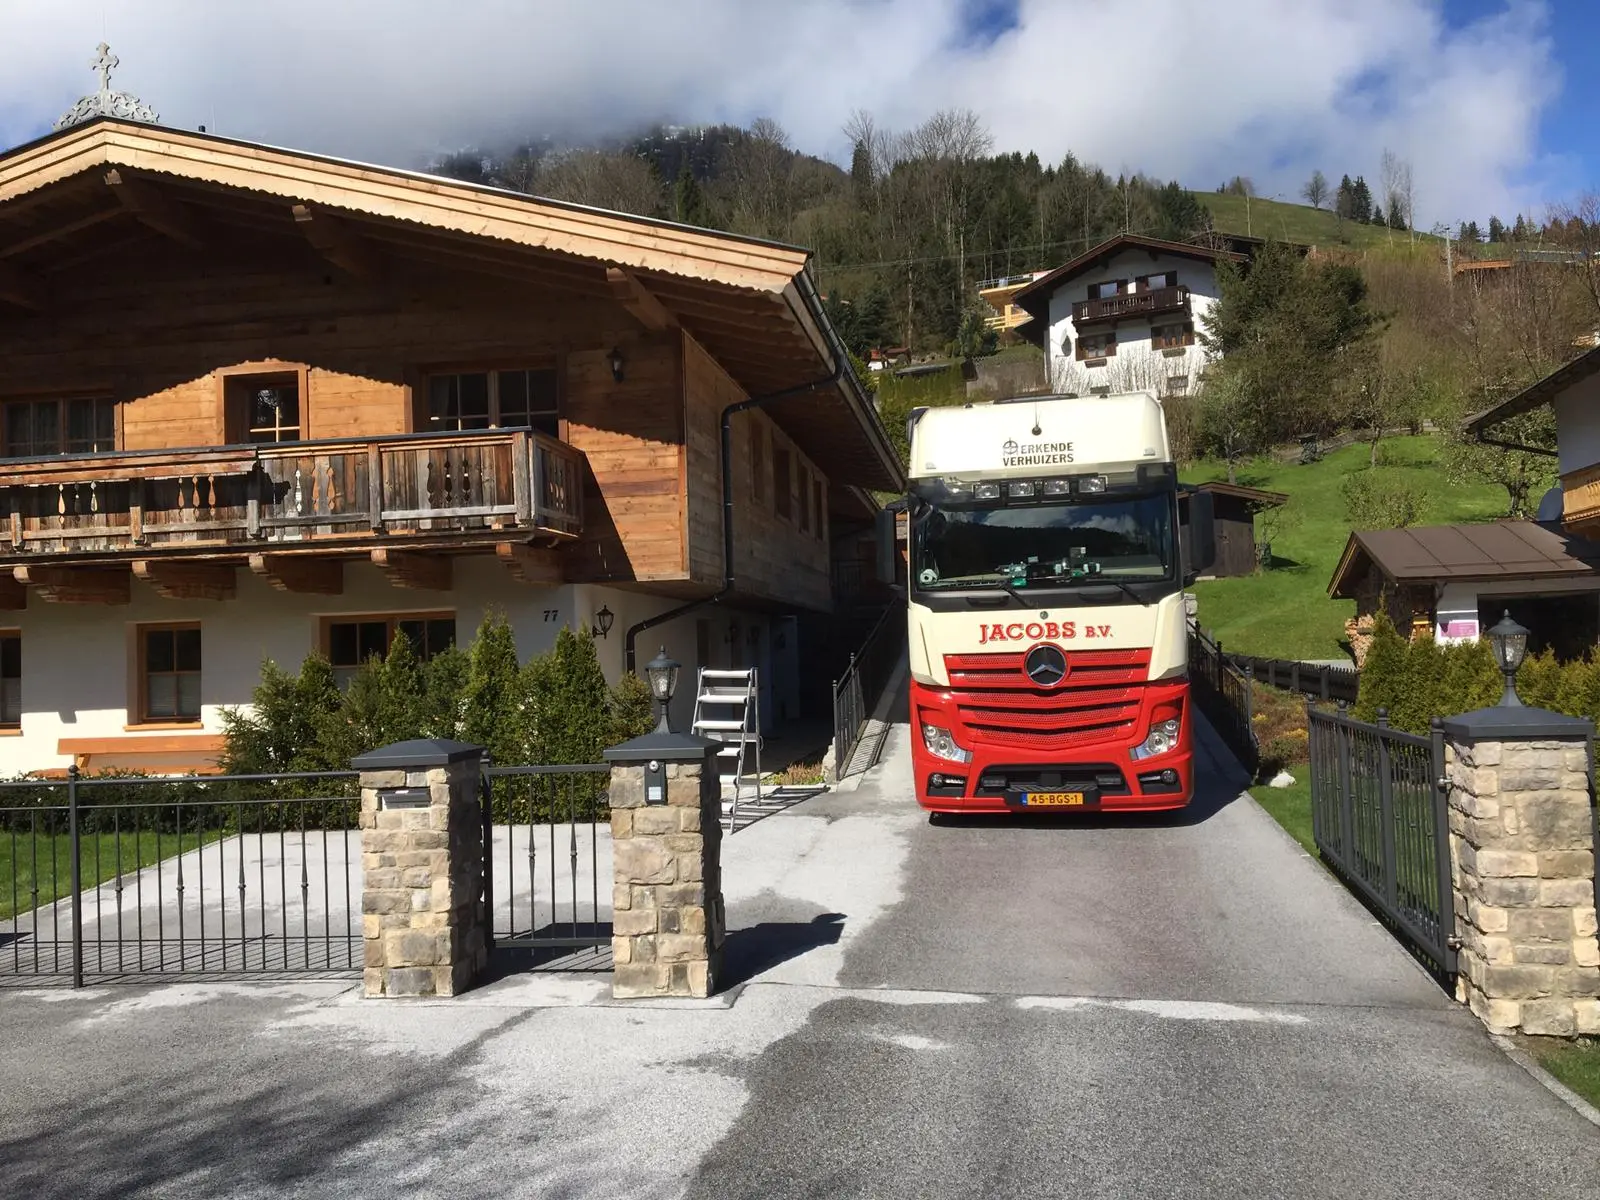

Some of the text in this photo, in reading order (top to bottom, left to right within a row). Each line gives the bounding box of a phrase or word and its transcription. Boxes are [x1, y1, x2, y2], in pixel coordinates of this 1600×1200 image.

[1020, 442, 1074, 455] ERKENDE
[1003, 454, 1074, 467] VERHUIZERS
[543, 610, 559, 622] 77
[979, 621, 1113, 644] JACOBS B.V.
[1031, 794, 1079, 804] 45-BGS-1
